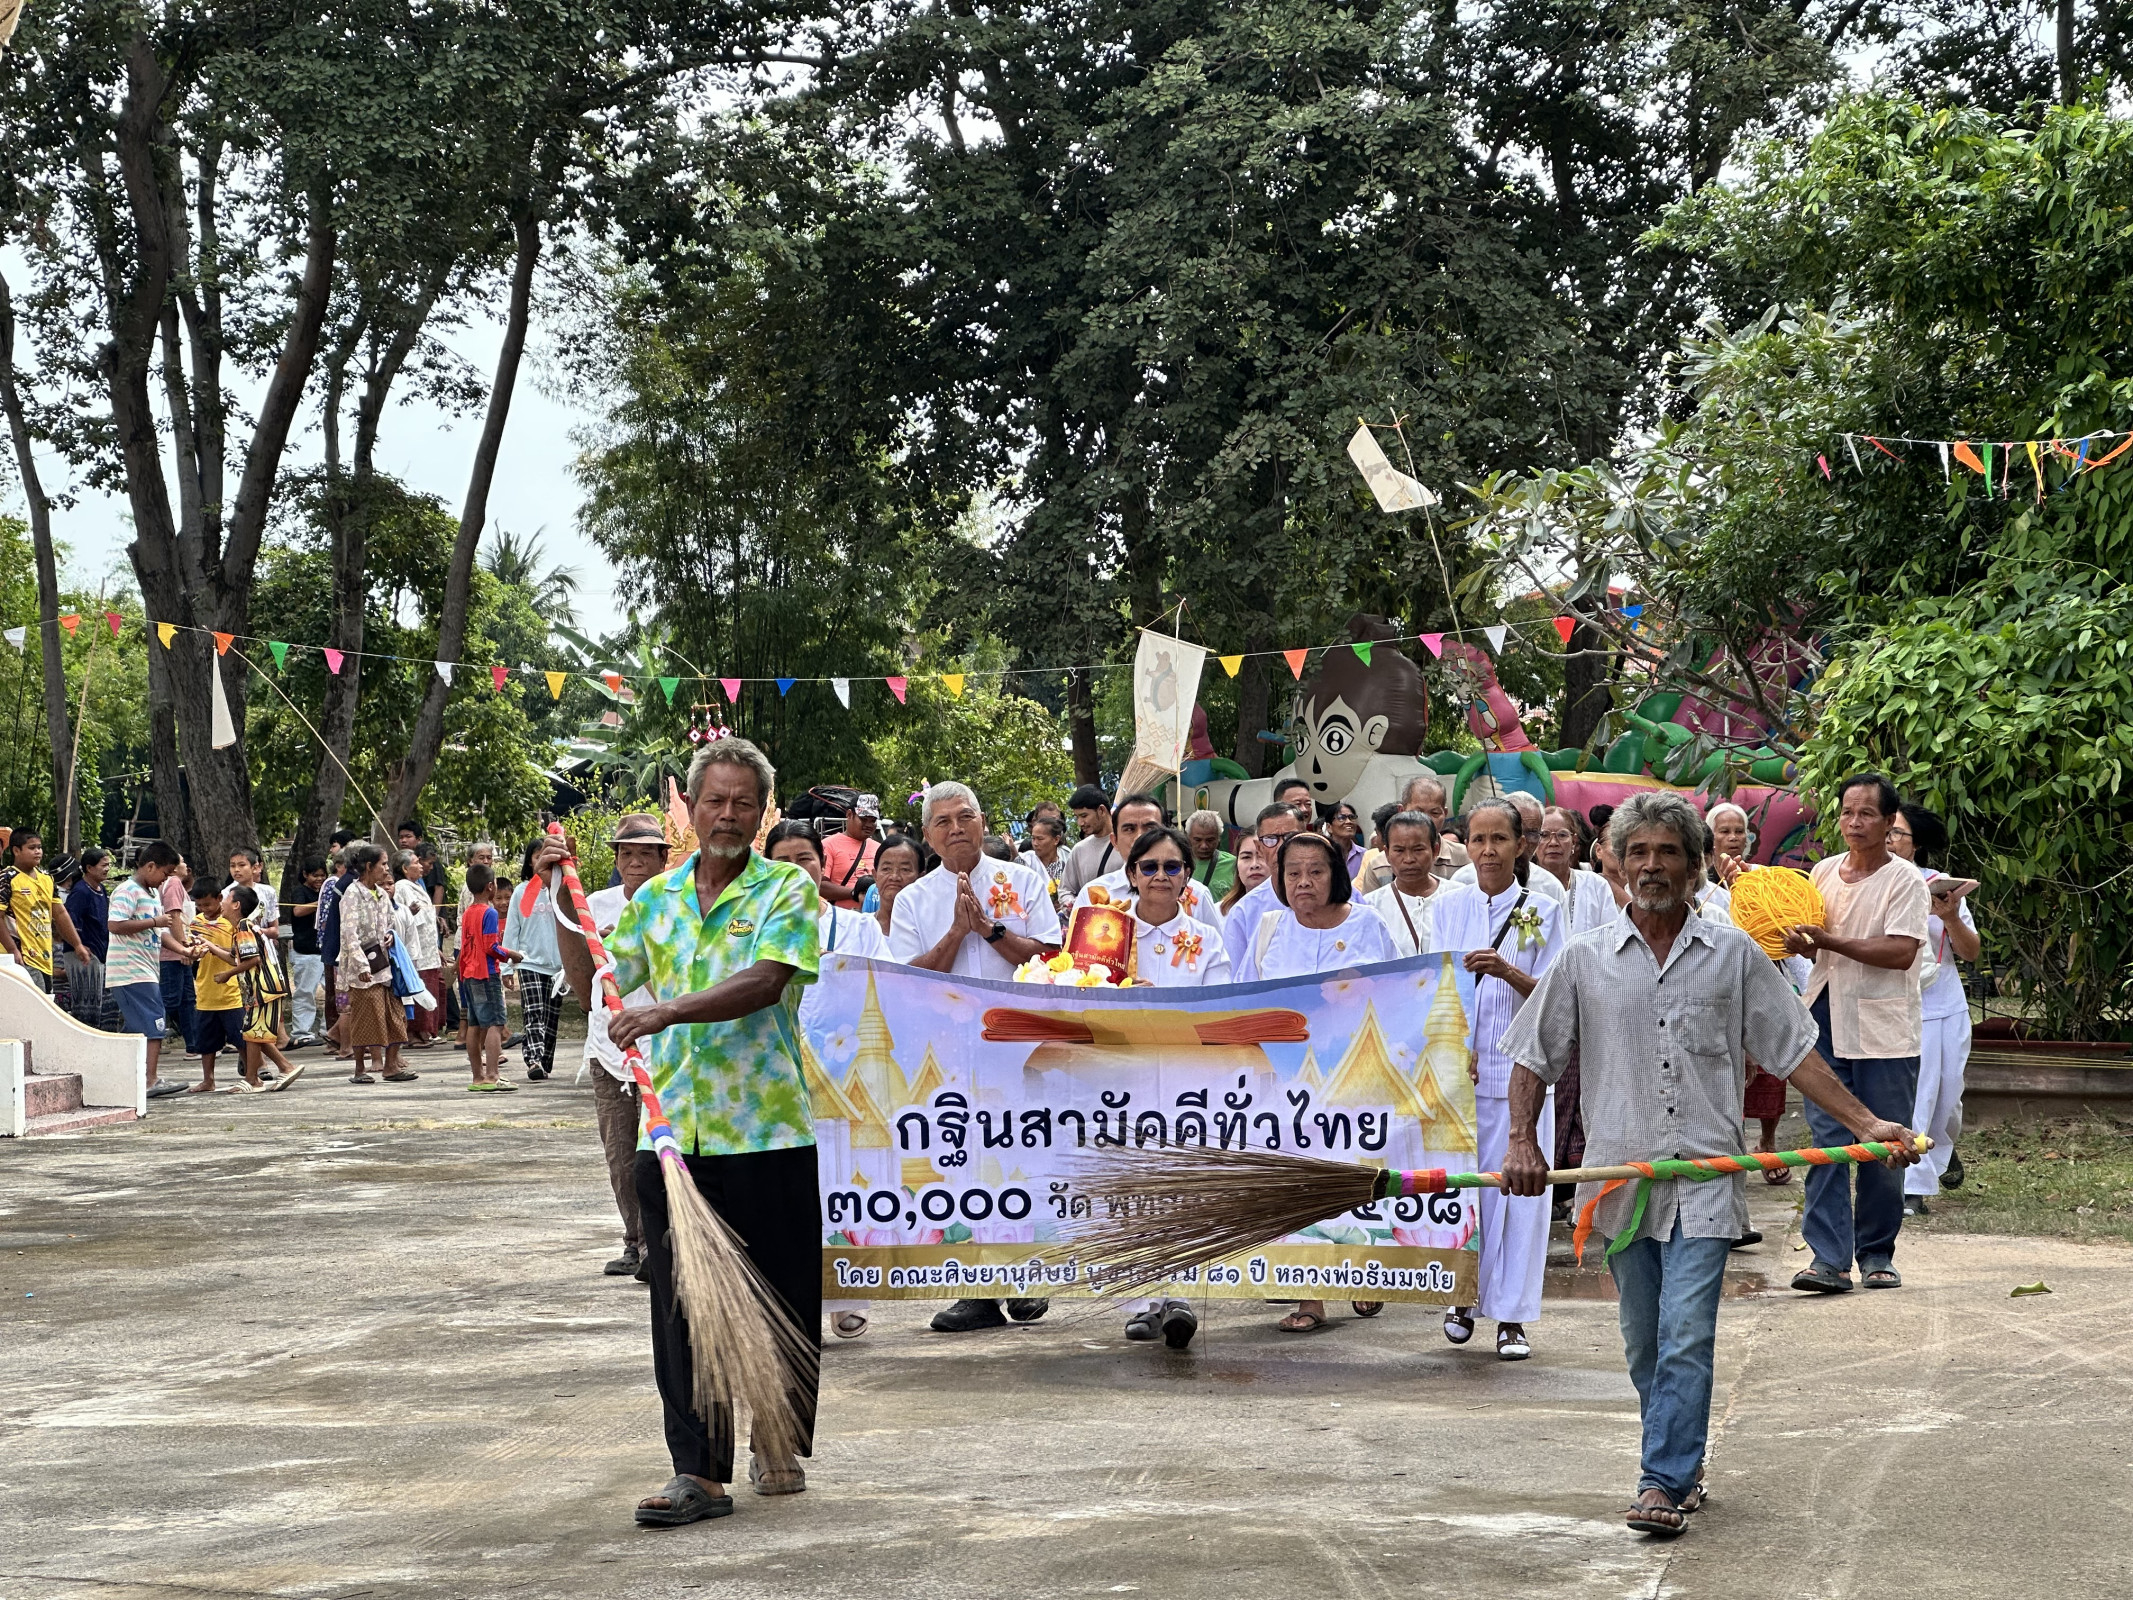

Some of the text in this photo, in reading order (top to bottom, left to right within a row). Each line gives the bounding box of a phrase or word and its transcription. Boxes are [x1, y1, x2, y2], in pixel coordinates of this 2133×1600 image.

[896, 1075, 1388, 1168] กฐินสามัคคีทั่วไทย
[827, 1187, 1032, 1231] ๓๐,๐๐๐
[1048, 1181, 1092, 1219] วัด
[836, 1260, 880, 1286] โดย
[890, 1257, 1077, 1291] คณะศิษยานุศิษย์
[1208, 1264, 1240, 1285] ๘๑
[1250, 1257, 1266, 1283] ปี
[1276, 1260, 1455, 1291] หลวงพ่อธัมมชโย
